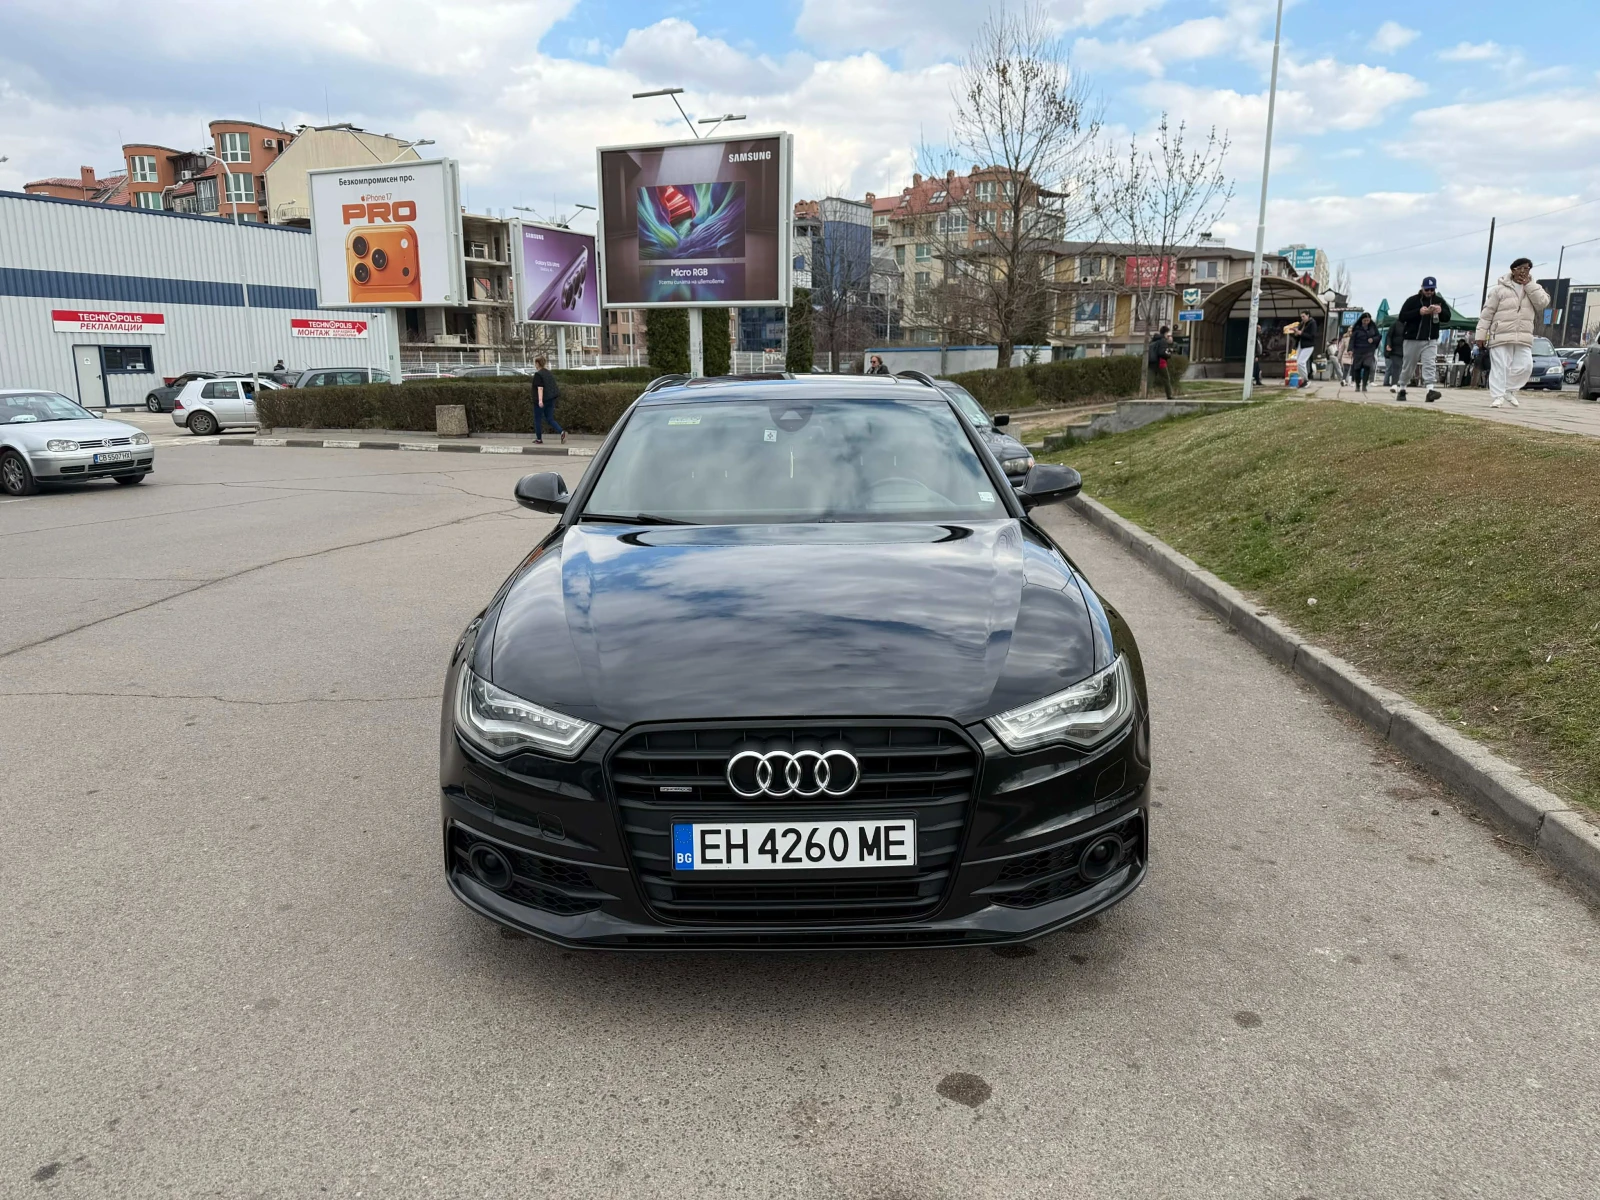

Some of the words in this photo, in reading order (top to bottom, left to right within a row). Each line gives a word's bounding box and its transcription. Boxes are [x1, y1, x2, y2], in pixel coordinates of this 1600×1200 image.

[728, 150, 772, 163] SAMSUNG
[338, 175, 398, 186] Безкомпромисен
[399, 174, 415, 184] про.
[365, 194, 386, 202] iPhone
[386, 192, 393, 200] 17
[341, 200, 417, 225] PRO
[525, 232, 545, 241] SAMSUNG
[534, 259, 547, 267] Galaxy
[670, 267, 692, 277] Micro
[692, 267, 709, 276] RGB
[78, 312, 143, 323] TECHNOPOLIS
[80, 322, 143, 332] РЕКЛАМАЦИИ
[308, 320, 352, 329] TECHNOPOLIS
[676, 852, 692, 865] BG
[700, 828, 748, 865] EH
[758, 826, 849, 864] 4260
[859, 825, 907, 861] ME
